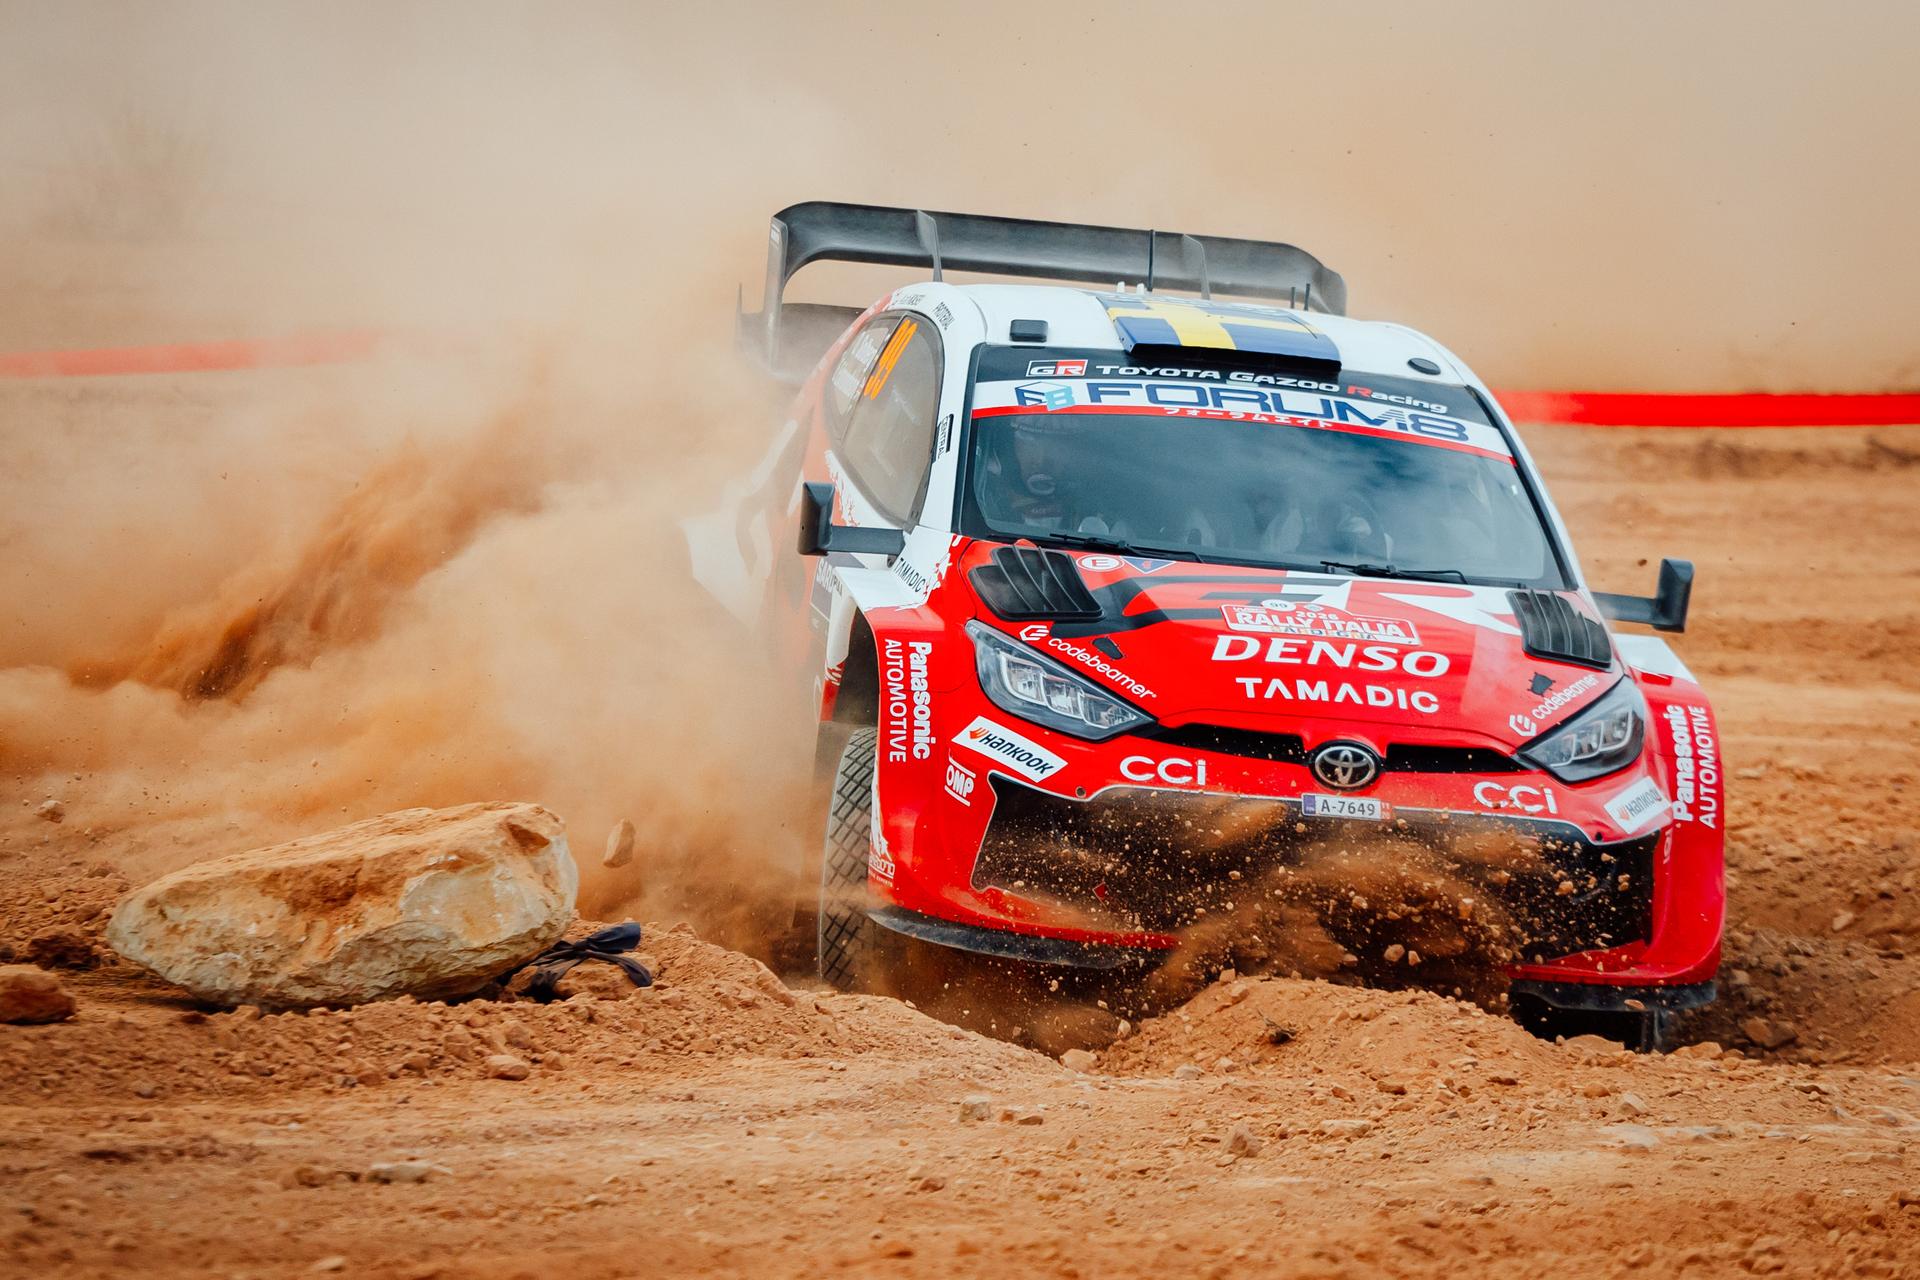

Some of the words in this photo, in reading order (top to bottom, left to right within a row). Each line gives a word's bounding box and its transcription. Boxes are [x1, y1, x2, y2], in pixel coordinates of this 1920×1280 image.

[1030, 364, 1083, 376] GR
[1096, 365, 1221, 380] TOYOTA
[1230, 371, 1340, 393] GAZOO
[1347, 384, 1448, 415] Racing
[1087, 382, 1470, 442] FORUM8
[893, 557, 926, 593] TAMADIC
[1236, 612, 1314, 628] RALLY
[1322, 619, 1407, 637] ITALIA
[1048, 637, 1153, 699] codebeamer
[1211, 634, 1450, 677] DENSO
[885, 638, 907, 763] AUTOMOTIVE
[909, 641, 937, 760] Panasonic
[1235, 677, 1440, 713] TAMADIC
[1532, 673, 1599, 719] codebeamer
[946, 764, 974, 798] OMP
[1663, 704, 1694, 821] Panasonic
[1687, 705, 1719, 829] AUTOMOTIVE
[1321, 799, 1375, 816] A-7649
